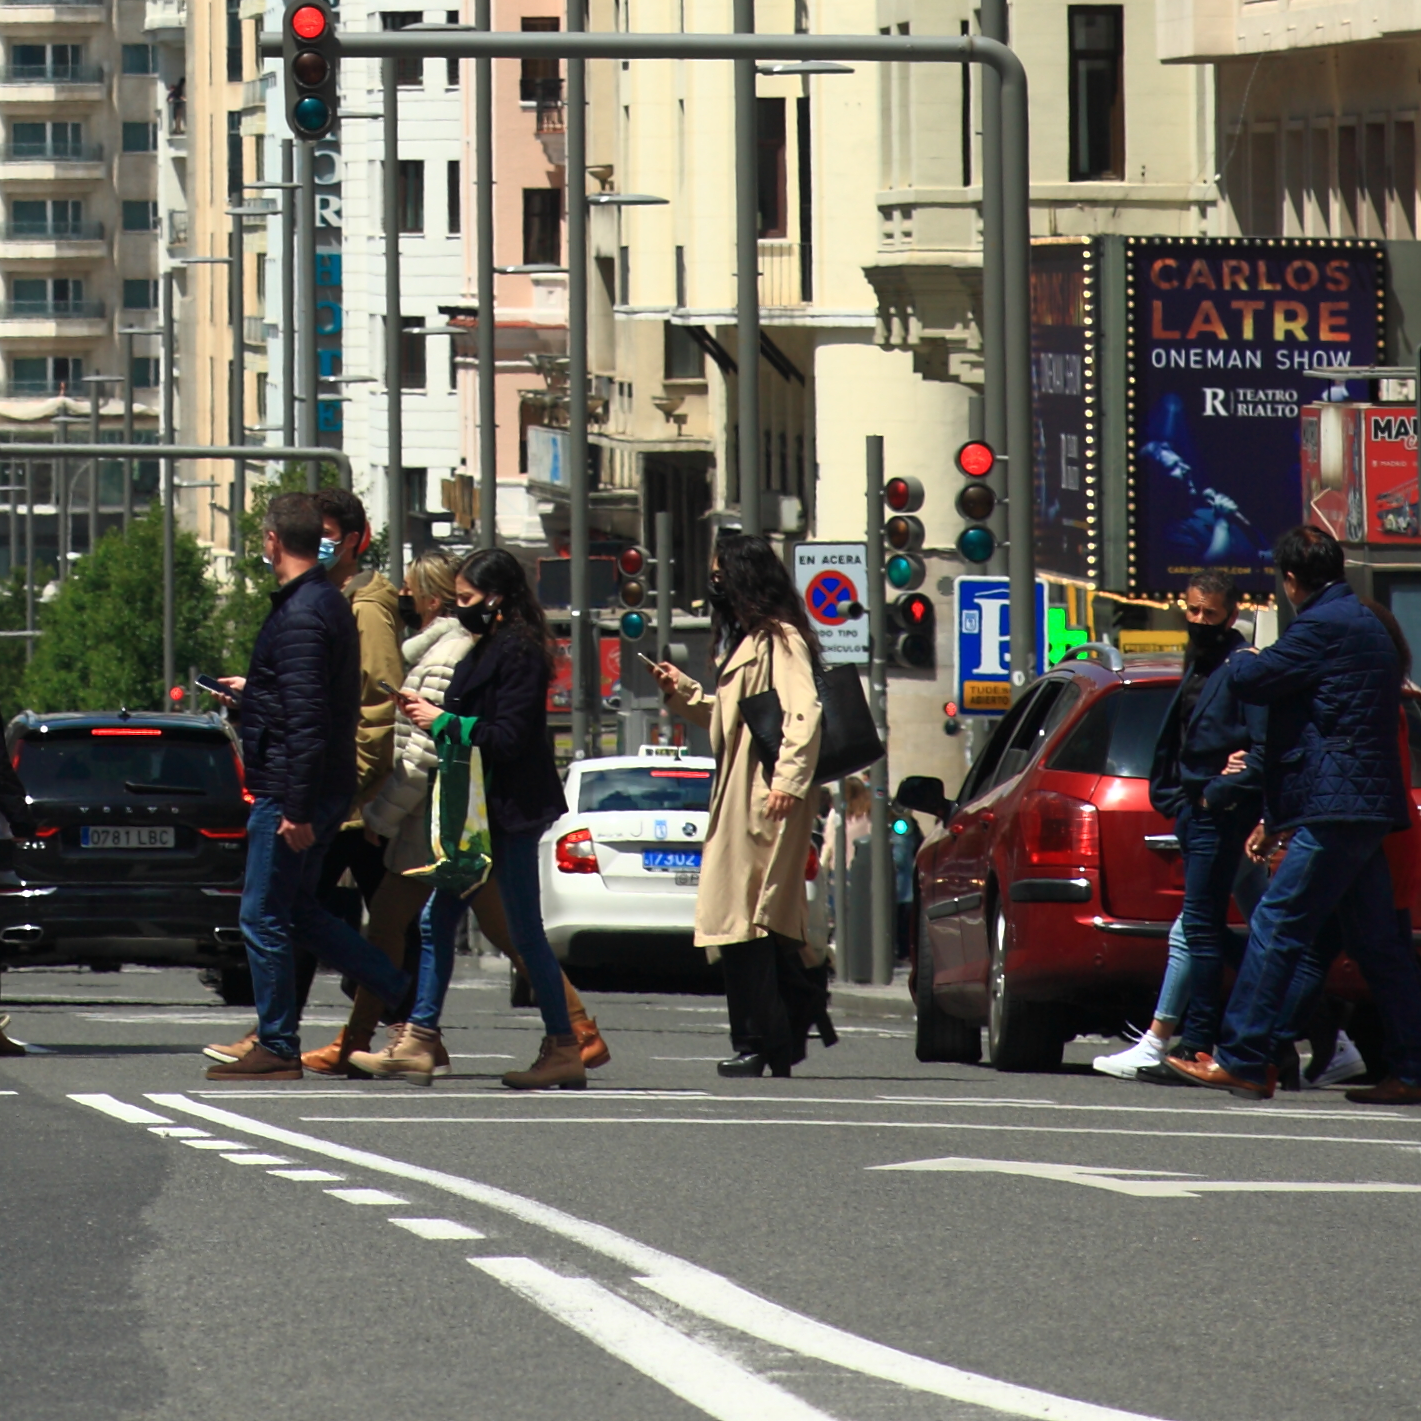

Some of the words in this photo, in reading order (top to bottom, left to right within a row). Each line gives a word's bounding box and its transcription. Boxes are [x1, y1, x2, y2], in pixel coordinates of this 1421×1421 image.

[1150, 258, 1351, 291] CARLOS
[1151, 300, 1351, 342] LATRE
[1152, 348, 1262, 369] ONEMAN
[1276, 350, 1351, 370] SHOW
[1236, 388, 1298, 402] TEATRO
[1237, 403, 1299, 418] RIALTO
[799, 555, 815, 565] EN
[821, 555, 862, 565] ACERA
[838, 629, 858, 637] TIPO
[91, 829, 130, 845] 0781
[138, 829, 169, 846] LBC
[655, 854, 695, 866] 7302
